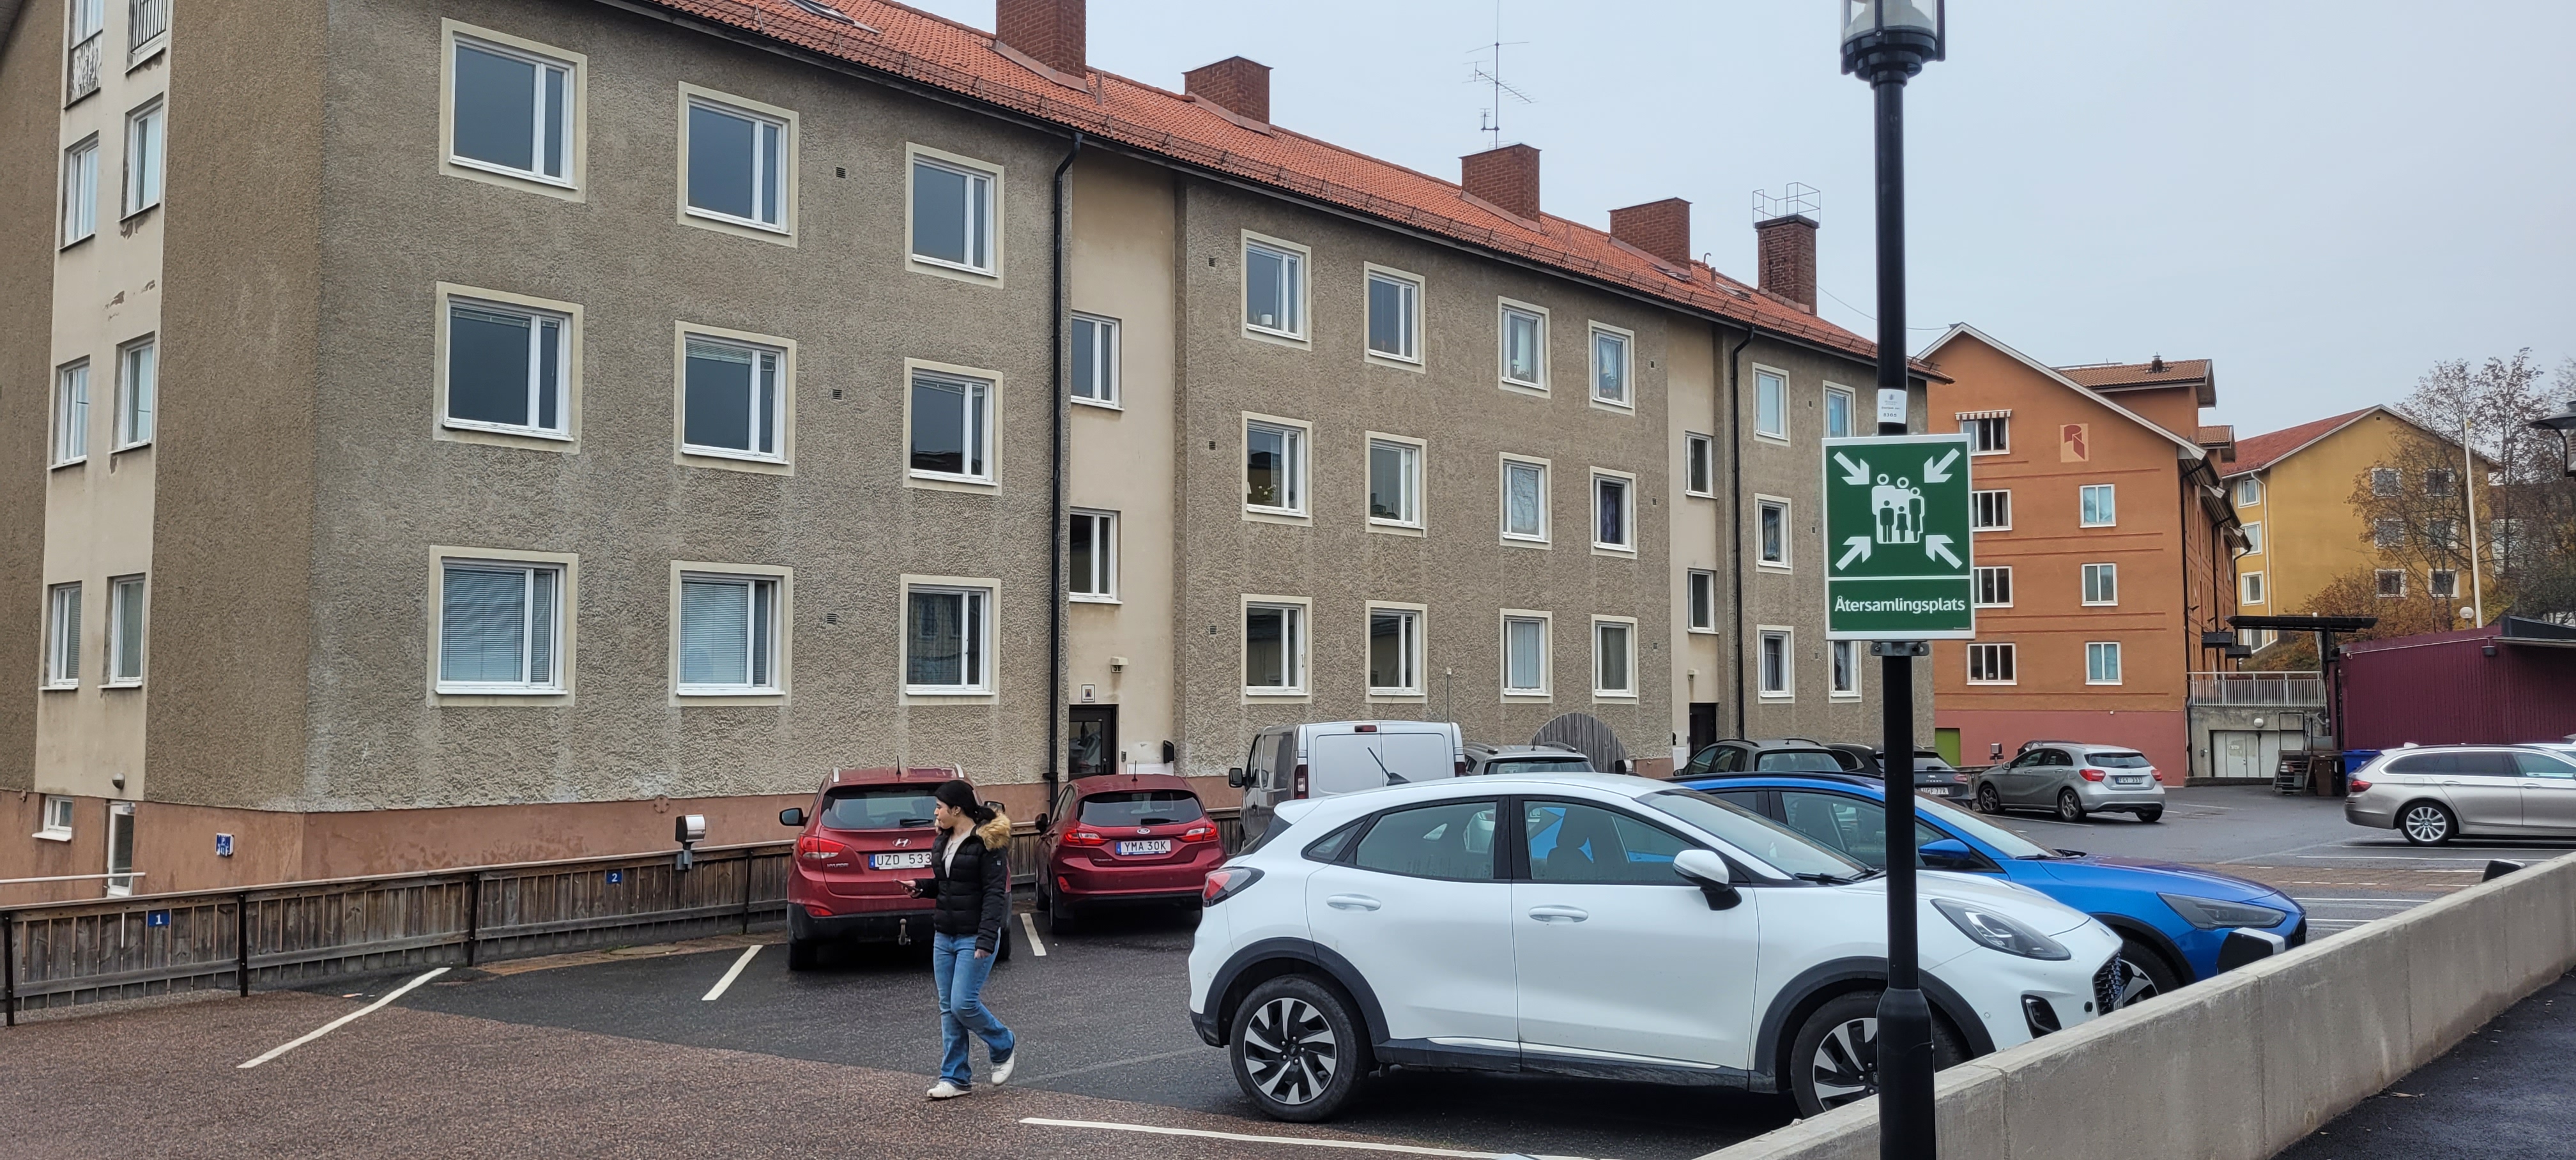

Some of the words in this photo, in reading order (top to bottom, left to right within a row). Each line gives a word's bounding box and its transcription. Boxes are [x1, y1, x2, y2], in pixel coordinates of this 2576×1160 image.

[1834, 595, 1966, 614] Återsamlingsplats
[1124, 842, 1144, 851] YMA
[1147, 841, 1167, 850] 30K
[877, 854, 900, 866] UZD
[908, 853, 931, 864] 533
[611, 873, 618, 882] 2
[155, 913, 163, 925] 1
